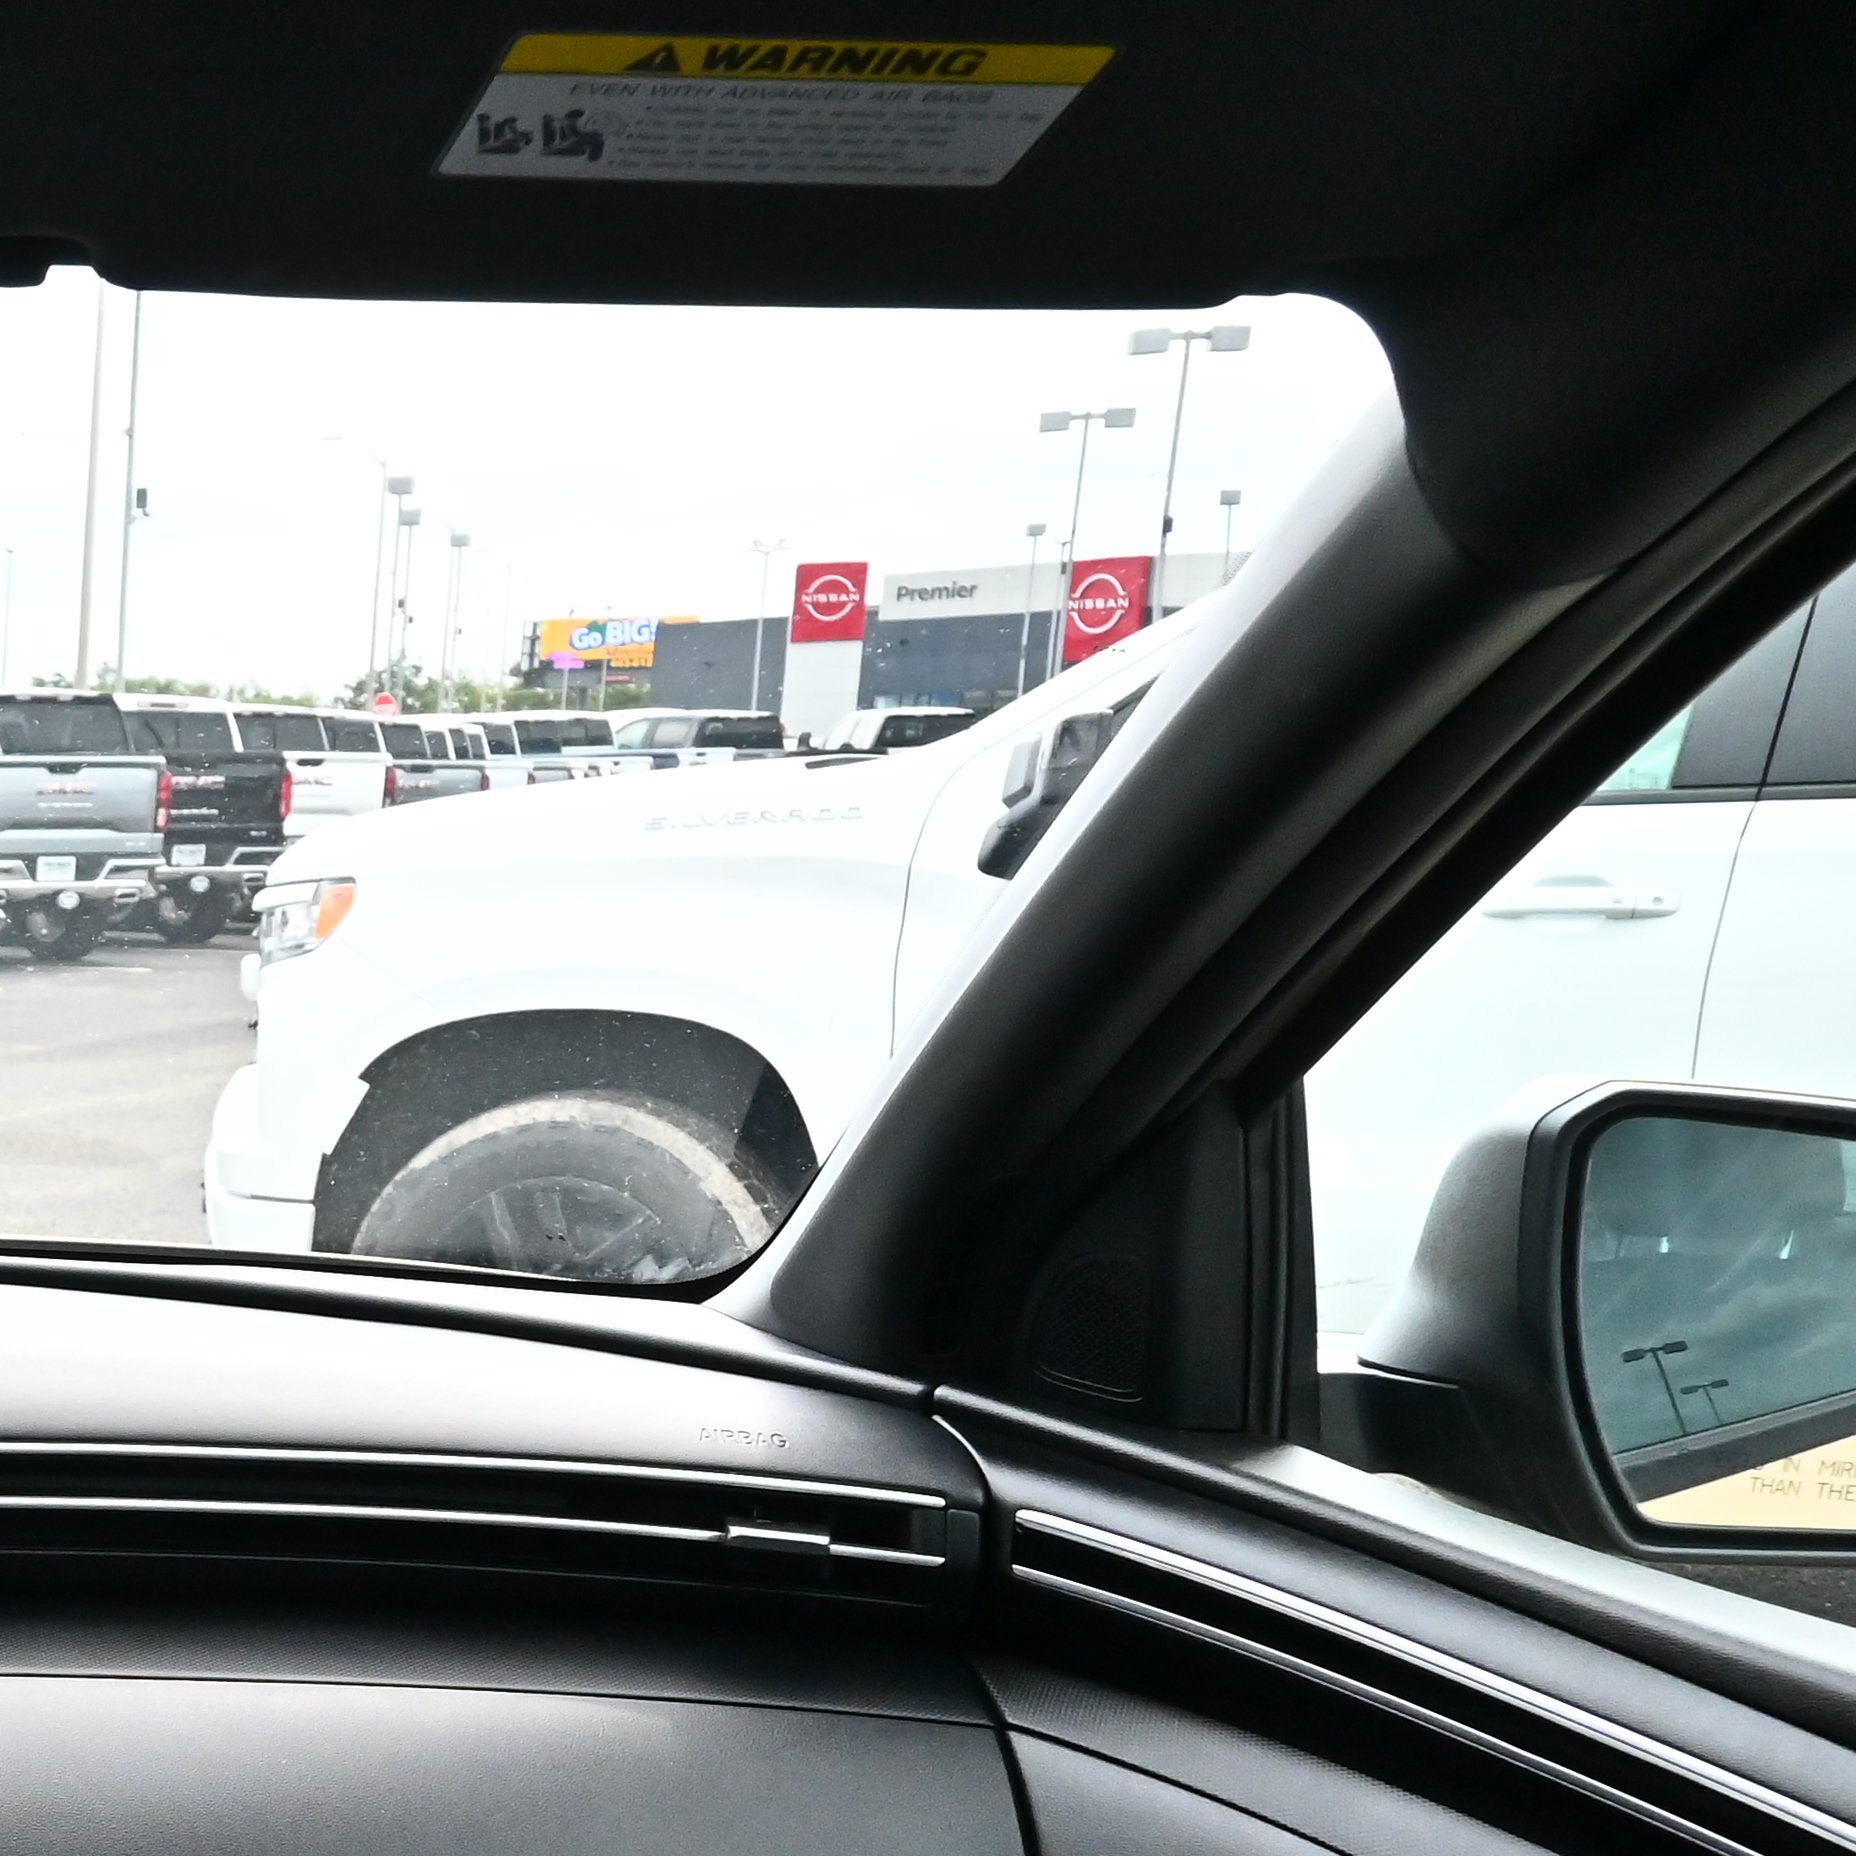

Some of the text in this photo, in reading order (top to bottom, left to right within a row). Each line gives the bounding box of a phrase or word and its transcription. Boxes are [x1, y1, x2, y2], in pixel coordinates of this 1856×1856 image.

[700, 44, 989, 78] WARNING
[569, 81, 638, 99] EVEN
[650, 83, 713, 99] WITH
[726, 84, 862, 102] ADVANCED
[801, 592, 860, 604] NISSAN
[897, 580, 978, 602] Premier
[1068, 596, 1129, 611] NISSAN
[571, 618, 659, 650] Go BIG!
[642, 805, 866, 832] SILVERADO
[698, 1426, 789, 1449] AIRBAG
[1783, 1459, 1801, 1473] IN
[1750, 1476, 1802, 1496] THAN
